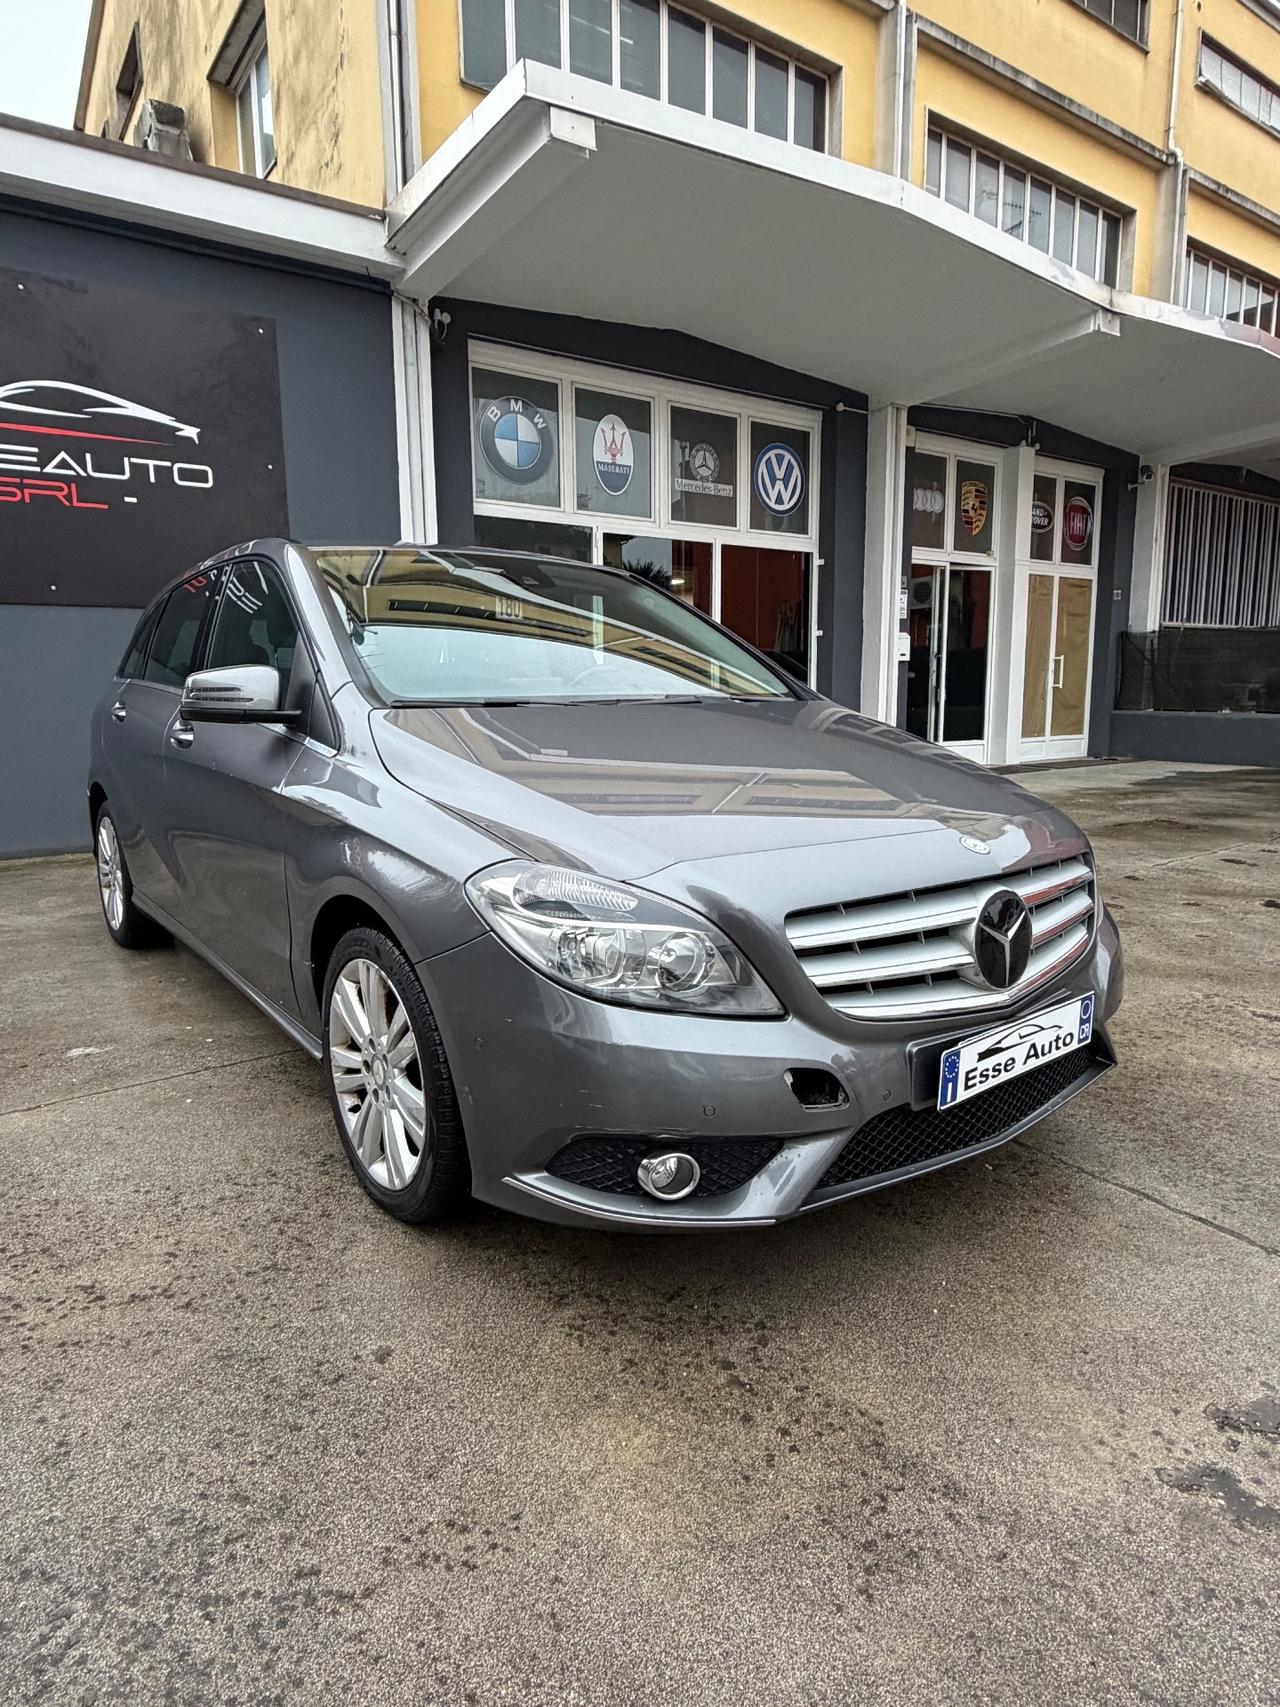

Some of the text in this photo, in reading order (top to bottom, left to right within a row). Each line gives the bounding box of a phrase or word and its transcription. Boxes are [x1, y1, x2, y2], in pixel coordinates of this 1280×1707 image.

[487, 398, 547, 430] BMW
[598, 463, 630, 475] MASERATI
[1032, 507, 1045, 517] AND
[1032, 516, 1049, 526] OVER
[1070, 511, 1087, 536] FIAT
[1079, 1023, 1089, 1039] CR
[964, 1031, 1074, 1091] Esse Auto
